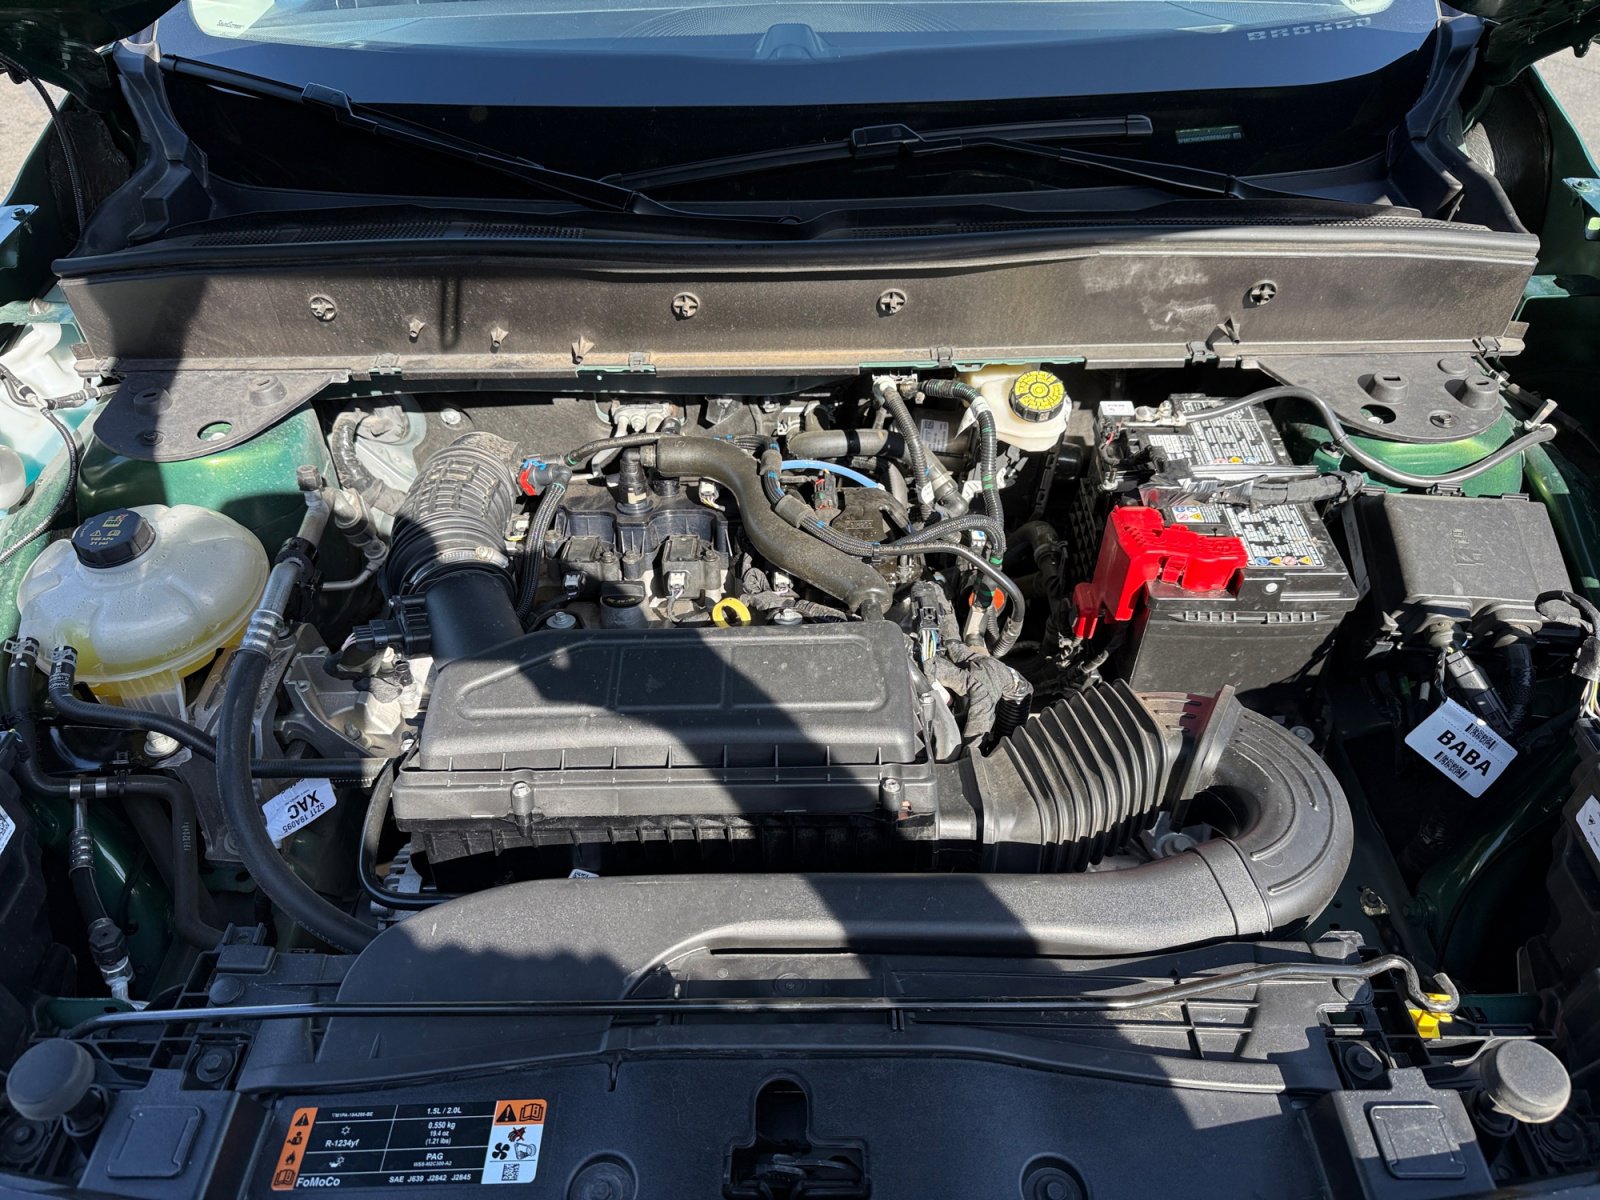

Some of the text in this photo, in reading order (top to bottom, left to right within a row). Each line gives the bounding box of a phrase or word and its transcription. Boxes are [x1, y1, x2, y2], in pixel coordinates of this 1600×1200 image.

[1246, 17, 1371, 41] BRONCO
[1437, 729, 1492, 777] BABA
[287, 790, 320, 819] XAC
[427, 1107, 442, 1115] 1.5L
[446, 1106, 462, 1114] 2.0L
[428, 1121, 456, 1130] 0.550 kg
[325, 1138, 360, 1149] R-1234yf
[426, 1152, 444, 1161] PAG
[296, 1176, 341, 1188] FoMoCo
[388, 1175, 405, 1183] SAE
[407, 1175, 424, 1183] J639
